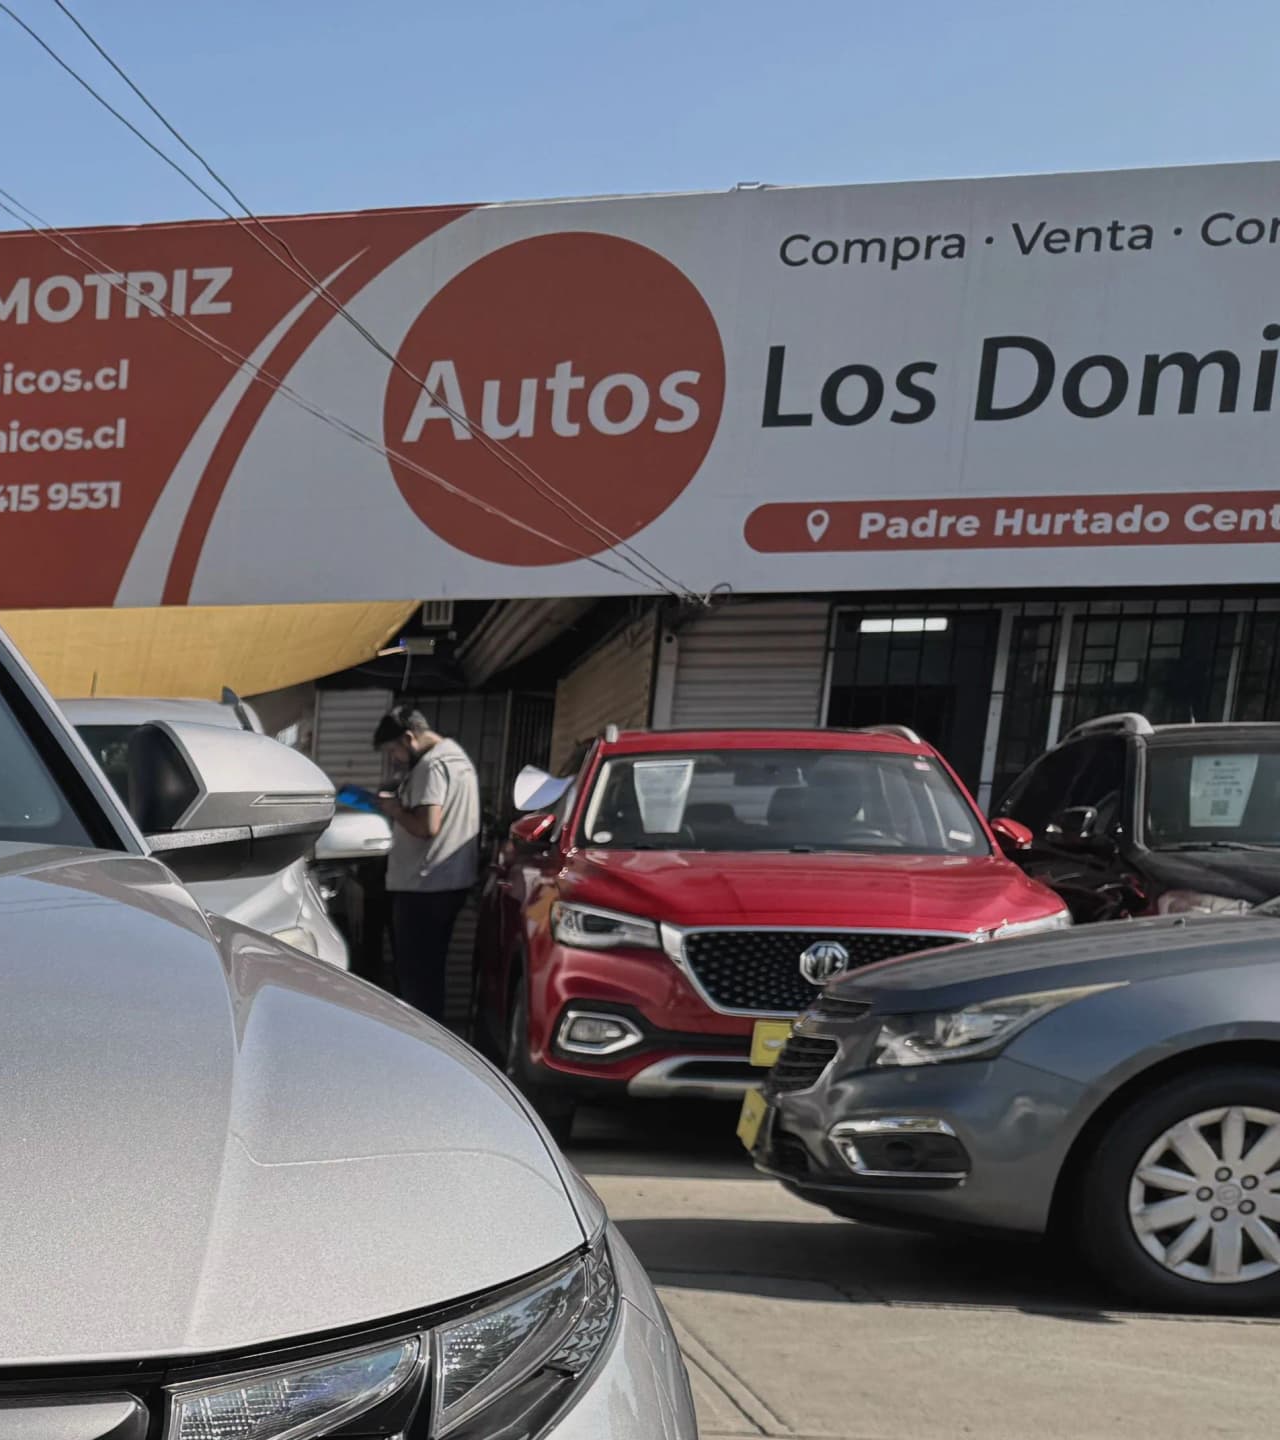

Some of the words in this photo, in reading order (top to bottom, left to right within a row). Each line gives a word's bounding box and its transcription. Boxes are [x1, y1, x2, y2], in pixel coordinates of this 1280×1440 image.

[779, 233, 966, 271] Compra
[1011, 219, 1153, 255] Venta
[401, 358, 702, 444] Autos
[761, 344, 939, 428] Los
[974, 322, 1280, 421] Domi
[47, 481, 121, 510] 9531
[859, 508, 981, 540] Padre
[993, 503, 1171, 537] Hurtado
